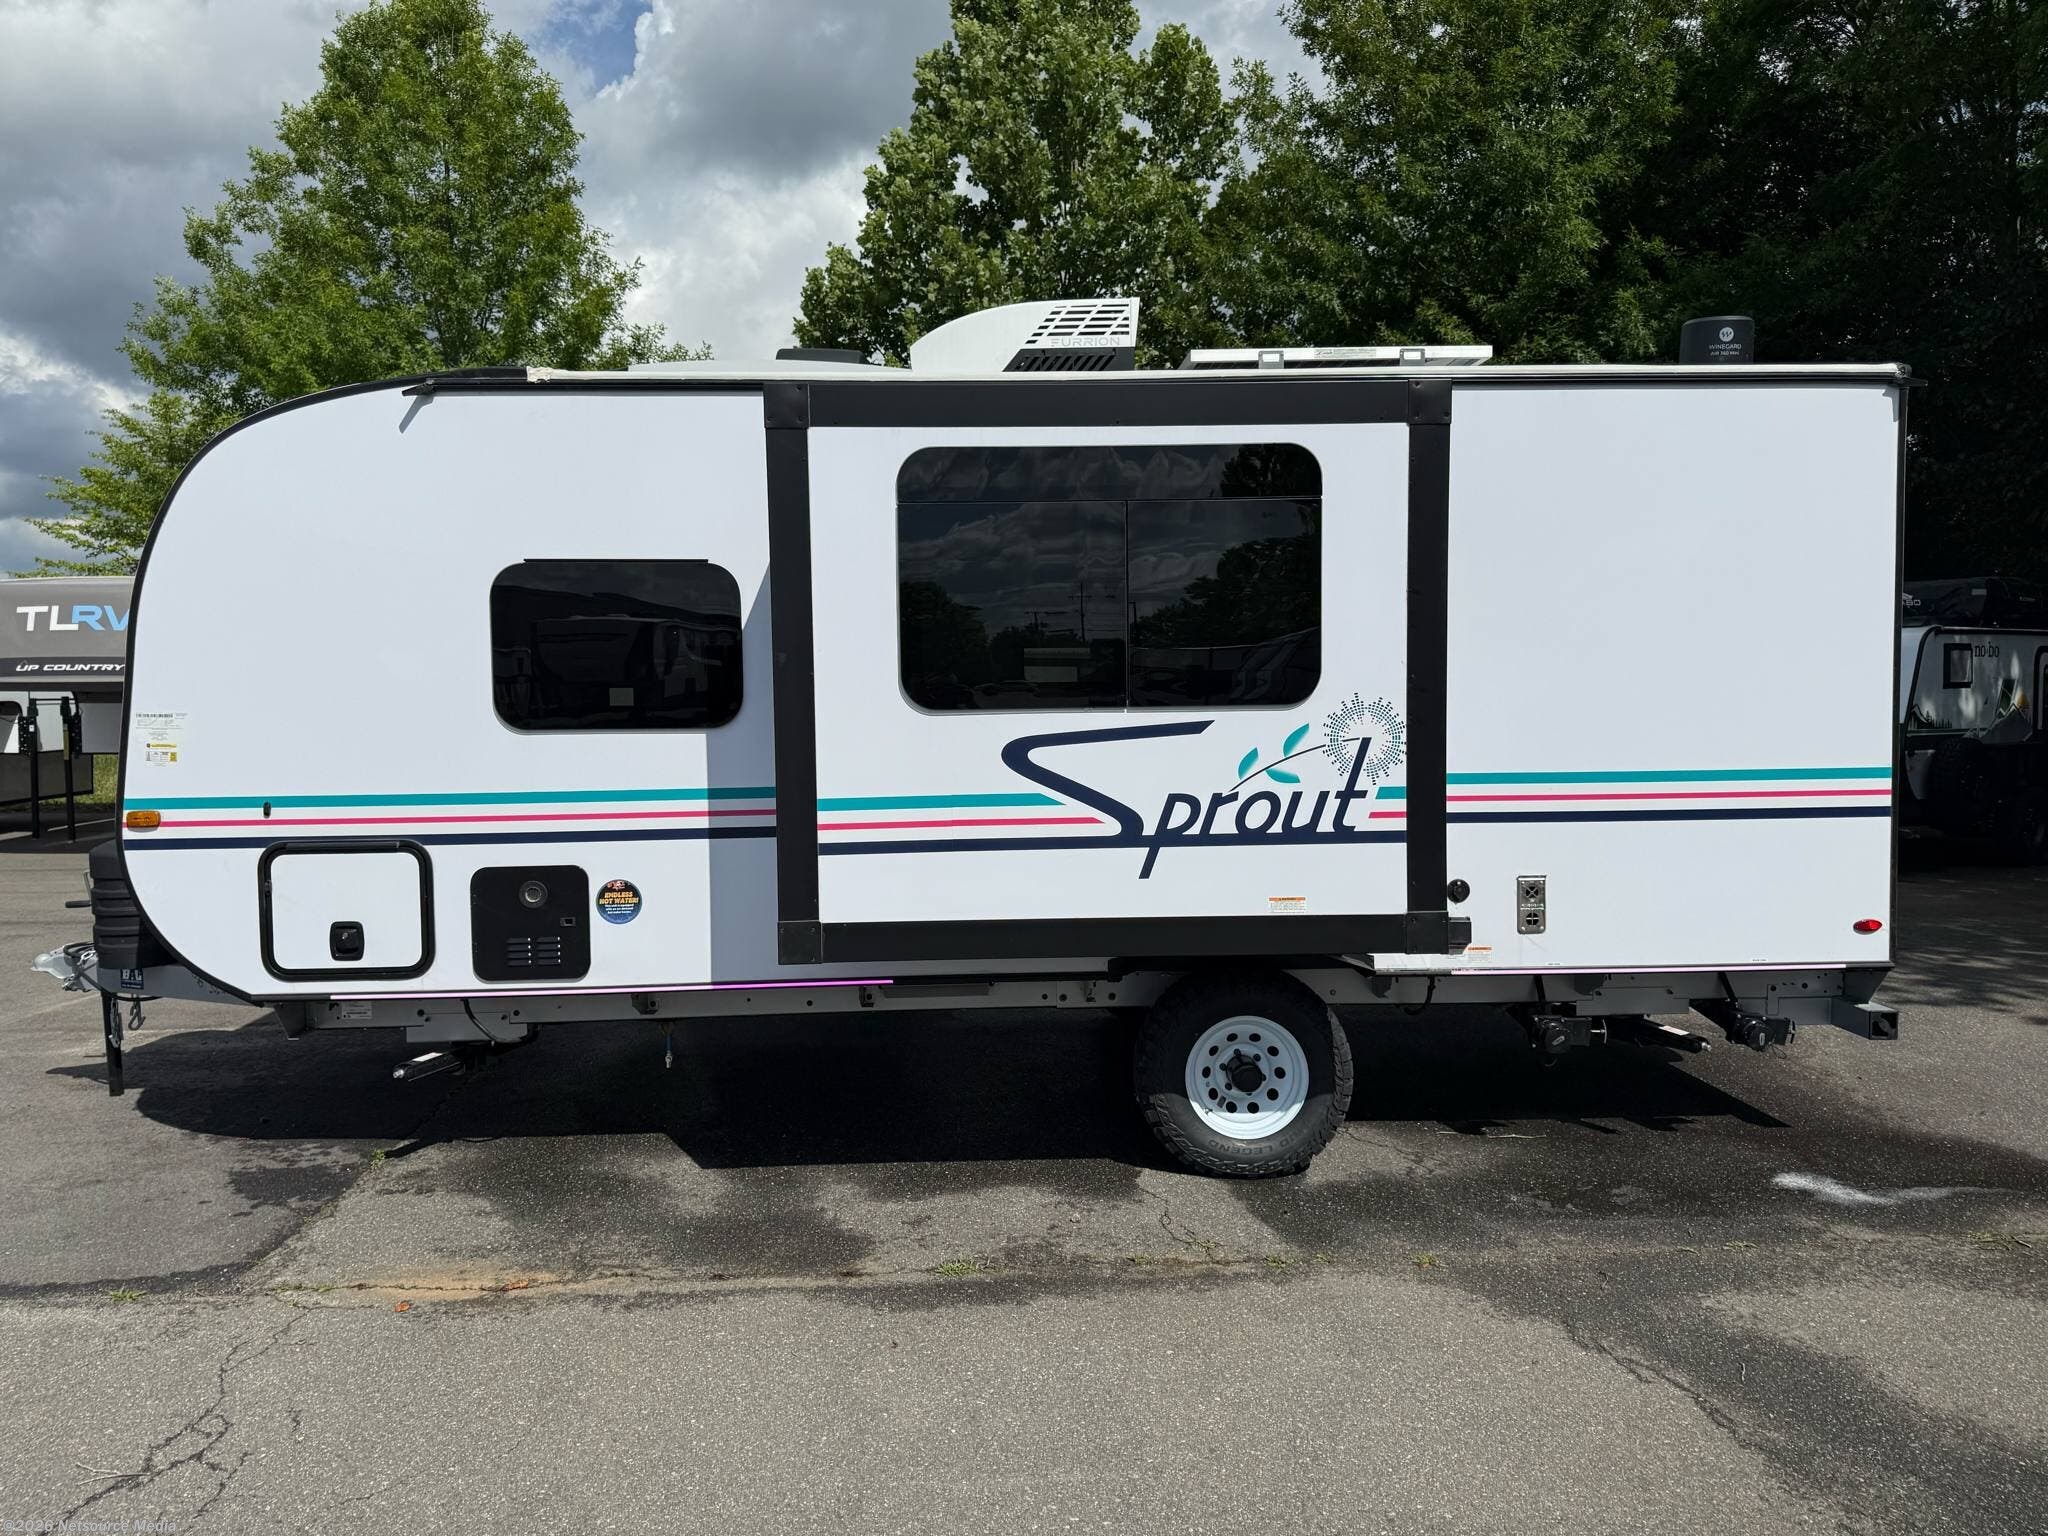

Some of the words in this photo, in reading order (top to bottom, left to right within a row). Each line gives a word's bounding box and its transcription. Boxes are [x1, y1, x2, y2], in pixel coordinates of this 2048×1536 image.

[1051, 337, 1120, 347] FURRION
[16, 605, 130, 632] TLRV
[16, 664, 39, 672] UP
[43, 664, 126, 672] COUNTRY
[1001, 720, 1368, 879] Sprout
[1208, 1139, 1273, 1156] LEGEND
